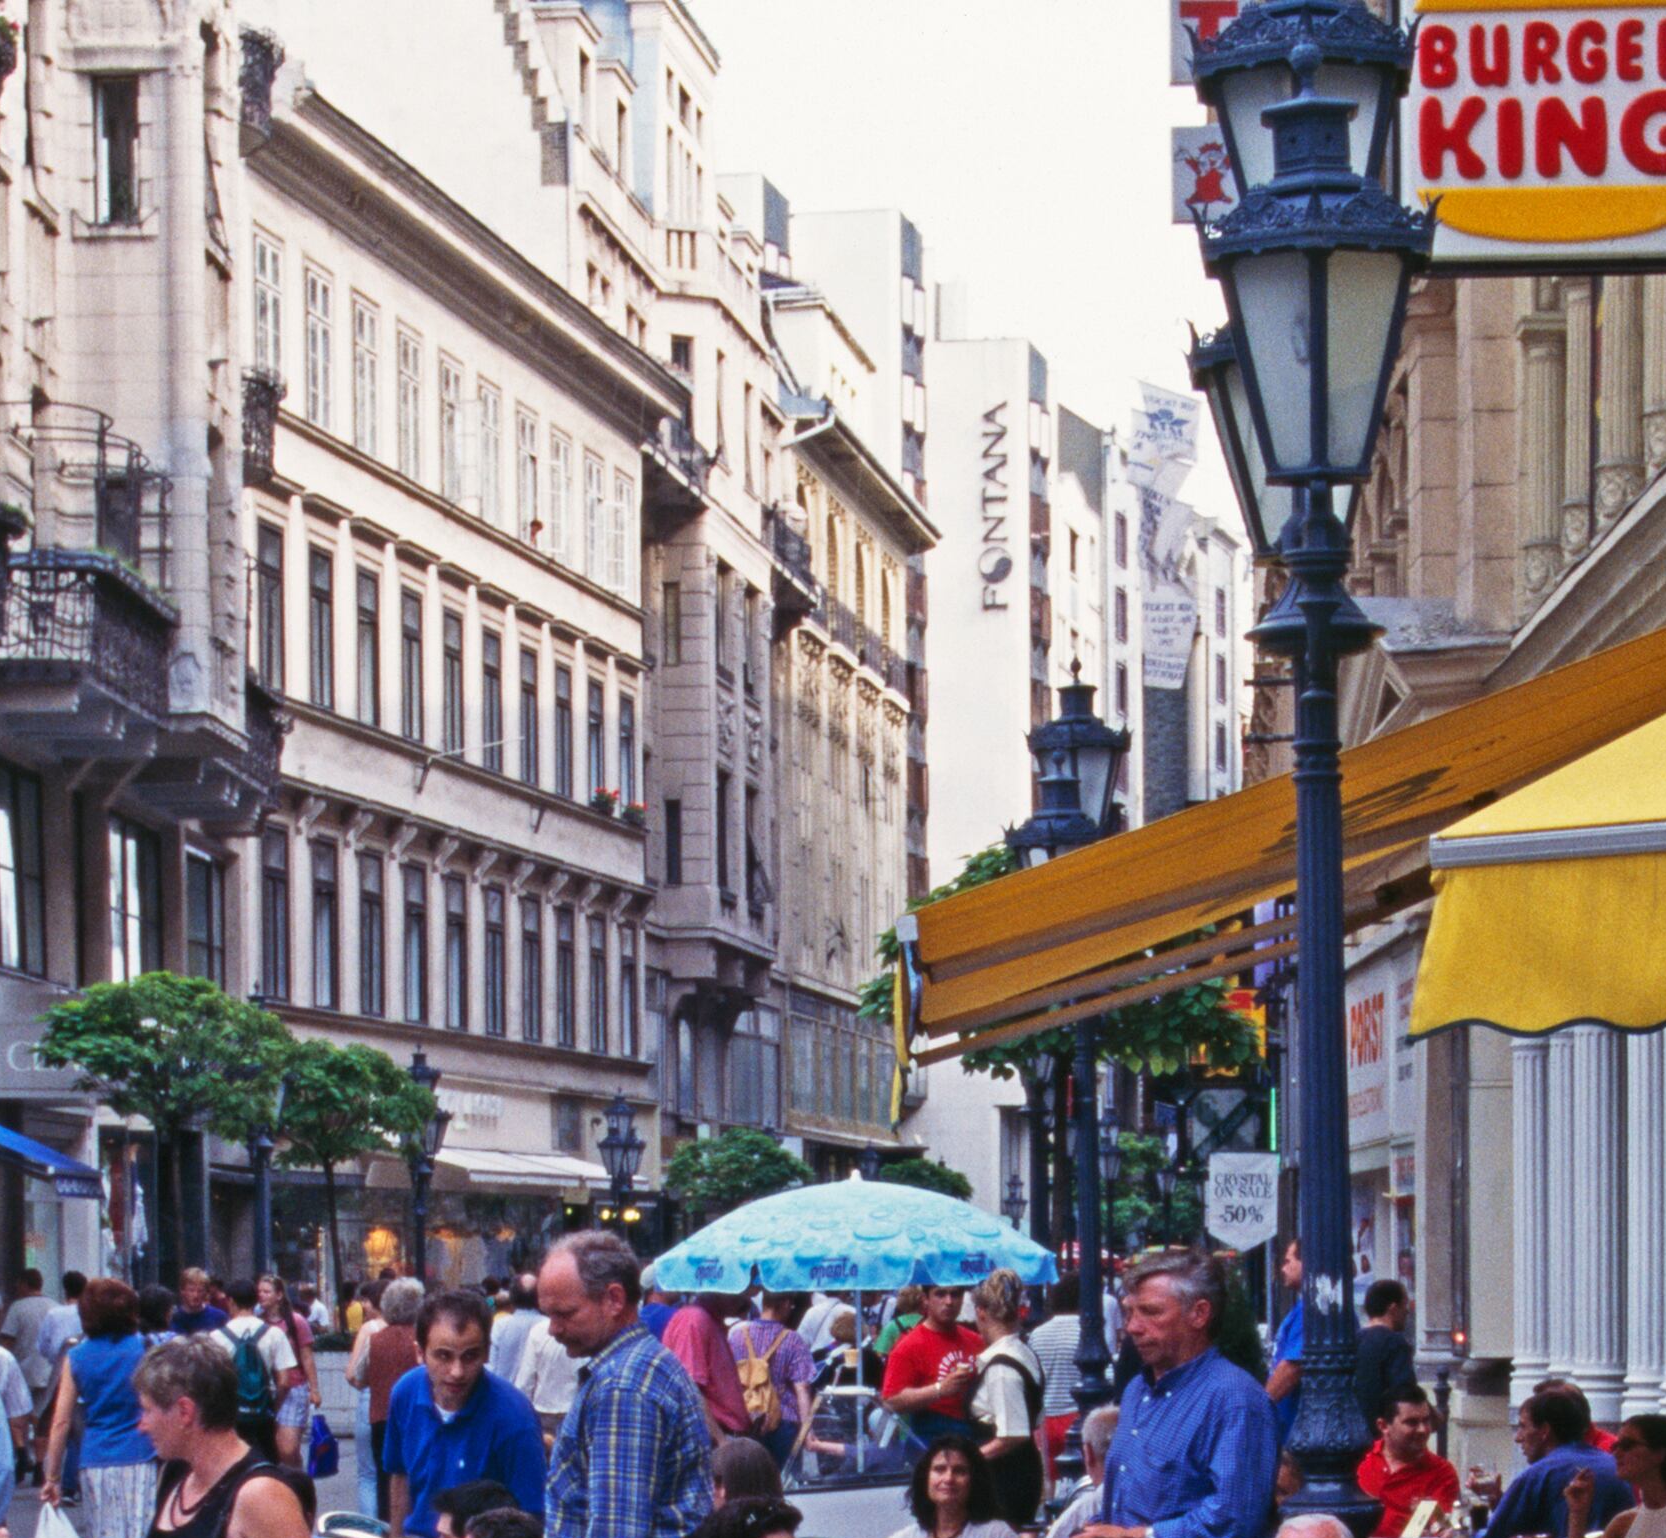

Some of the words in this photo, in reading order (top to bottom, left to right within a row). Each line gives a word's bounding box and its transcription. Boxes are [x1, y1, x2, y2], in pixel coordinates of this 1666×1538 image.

[978, 401, 1013, 611] FONTANA
[1214, 1173, 1271, 1186] CRYSTAL
[1214, 1186, 1233, 1199] ON
[1239, 1186, 1272, 1199] SALE
[1219, 1204, 1264, 1224] -50%
